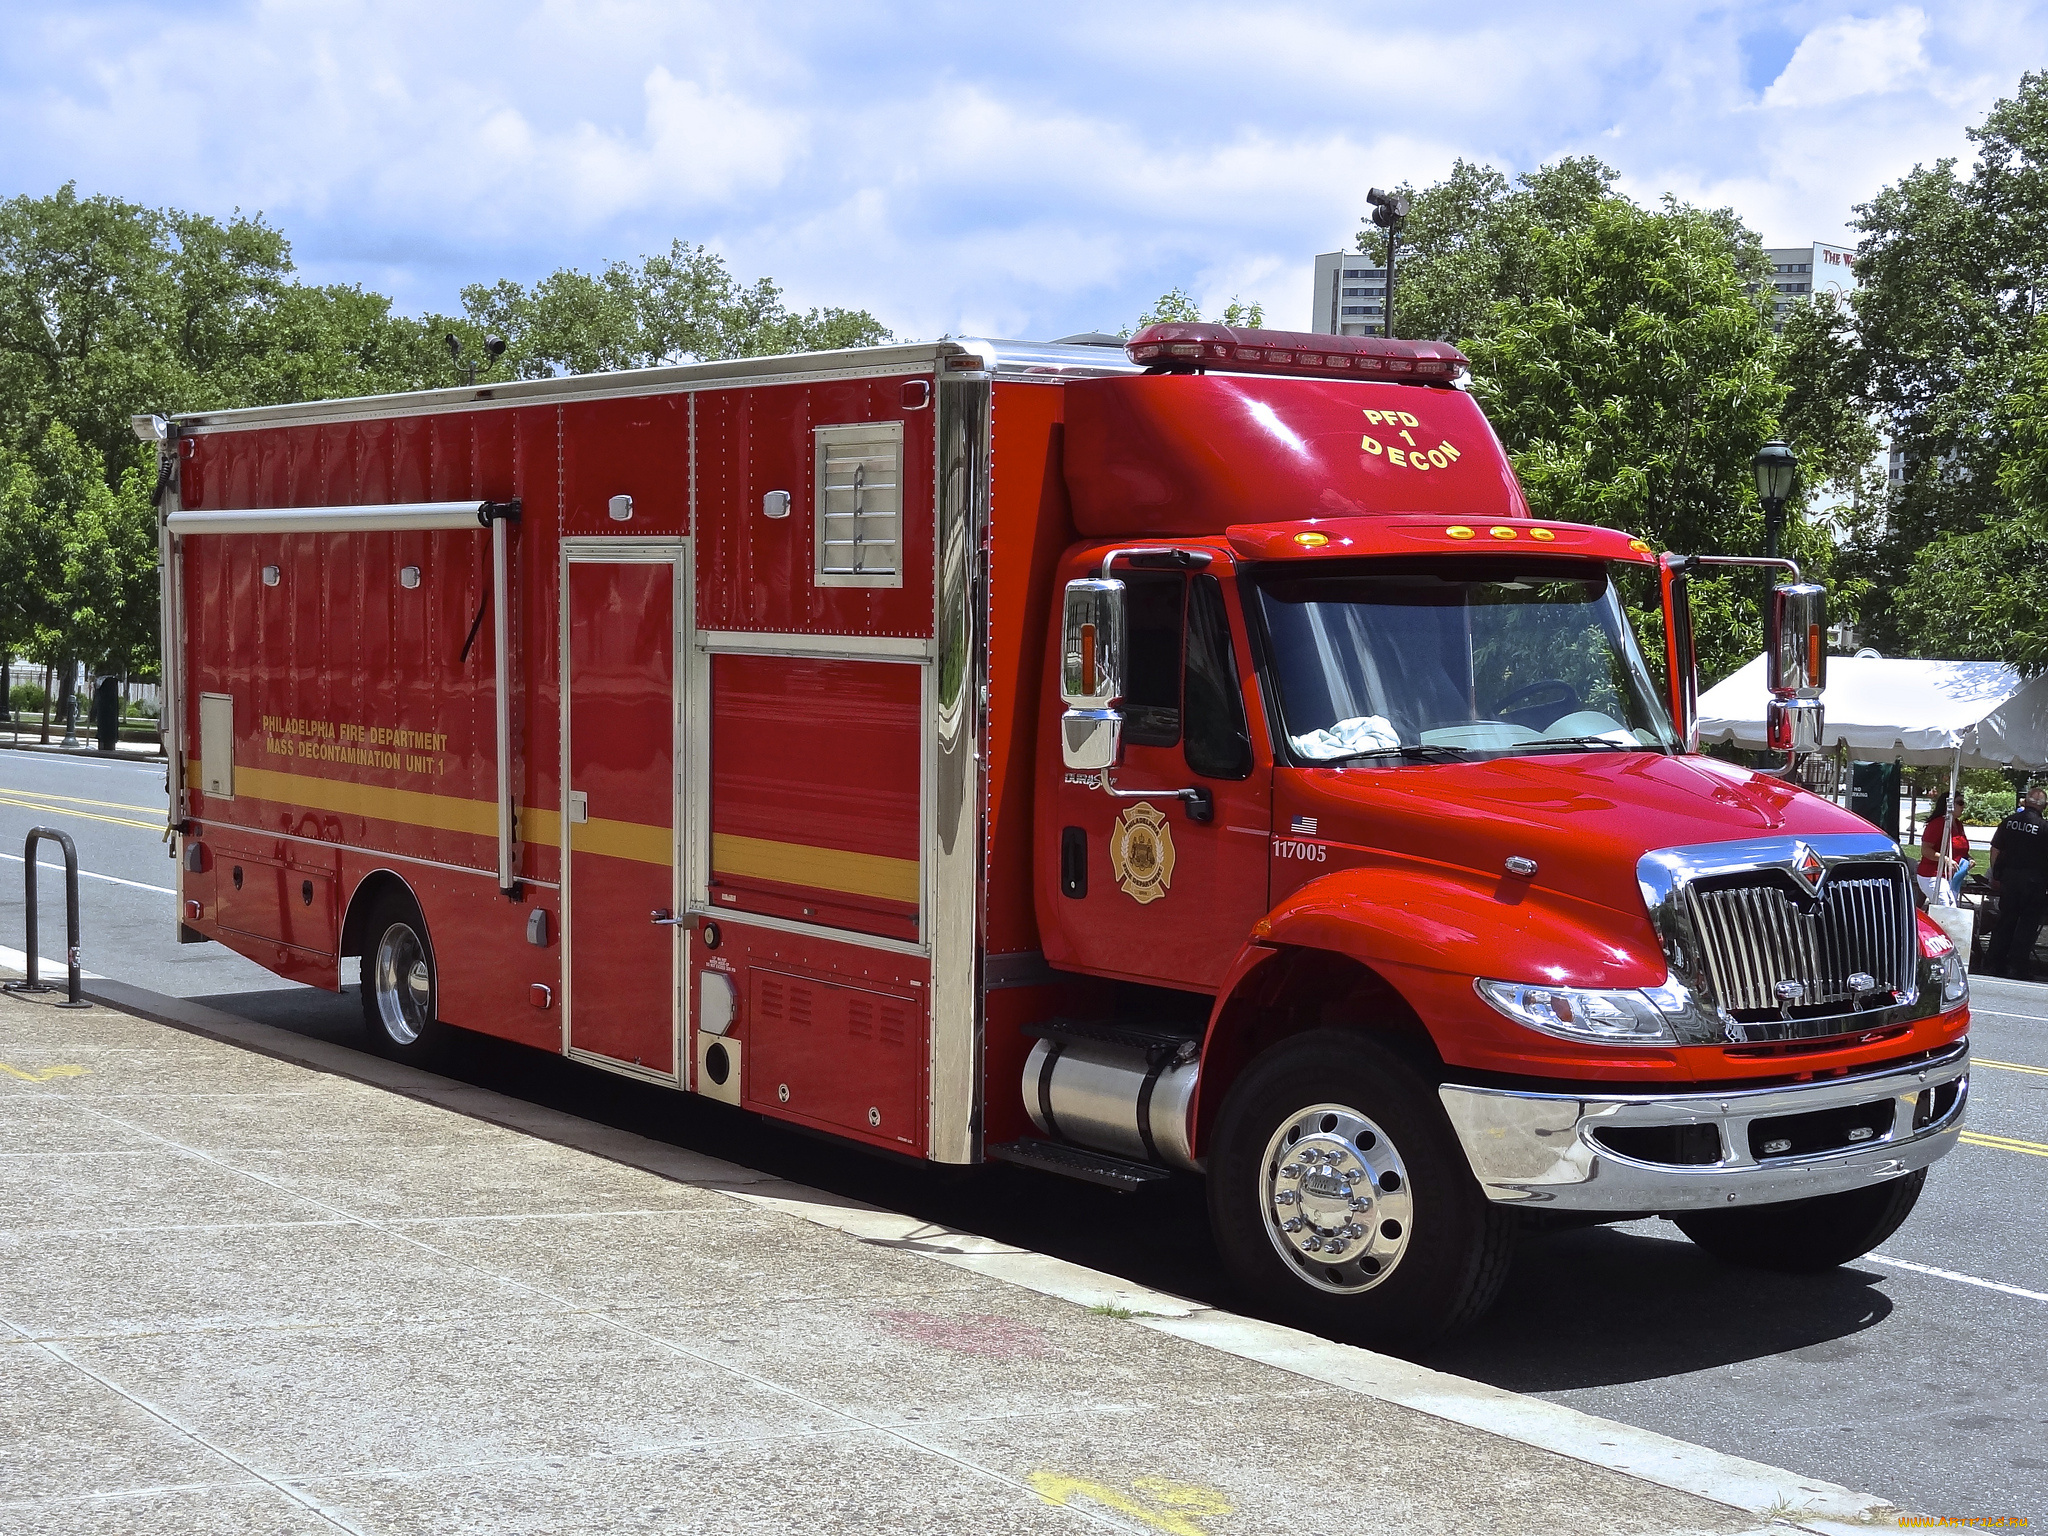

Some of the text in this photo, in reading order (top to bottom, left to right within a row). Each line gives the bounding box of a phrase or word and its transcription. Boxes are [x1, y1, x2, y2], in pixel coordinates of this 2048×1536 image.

[1823, 249, 1841, 266] THE
[1362, 409, 1419, 427] PFD
[1398, 429, 1417, 447] 1
[1361, 435, 1461, 471] DECON
[262, 714, 448, 752] PHILADELPHIA FIRE DEPARTMENT
[266, 737, 444, 776] MASS DECONTAMINATION UNIT 1
[1125, 817, 1161, 837] PHILADELPHIA
[2006, 820, 2039, 835] POLICE
[1272, 839, 1327, 862] 117005
[1122, 863, 1133, 879] FIRE
[1132, 866, 1163, 888] DEPARTMENT
